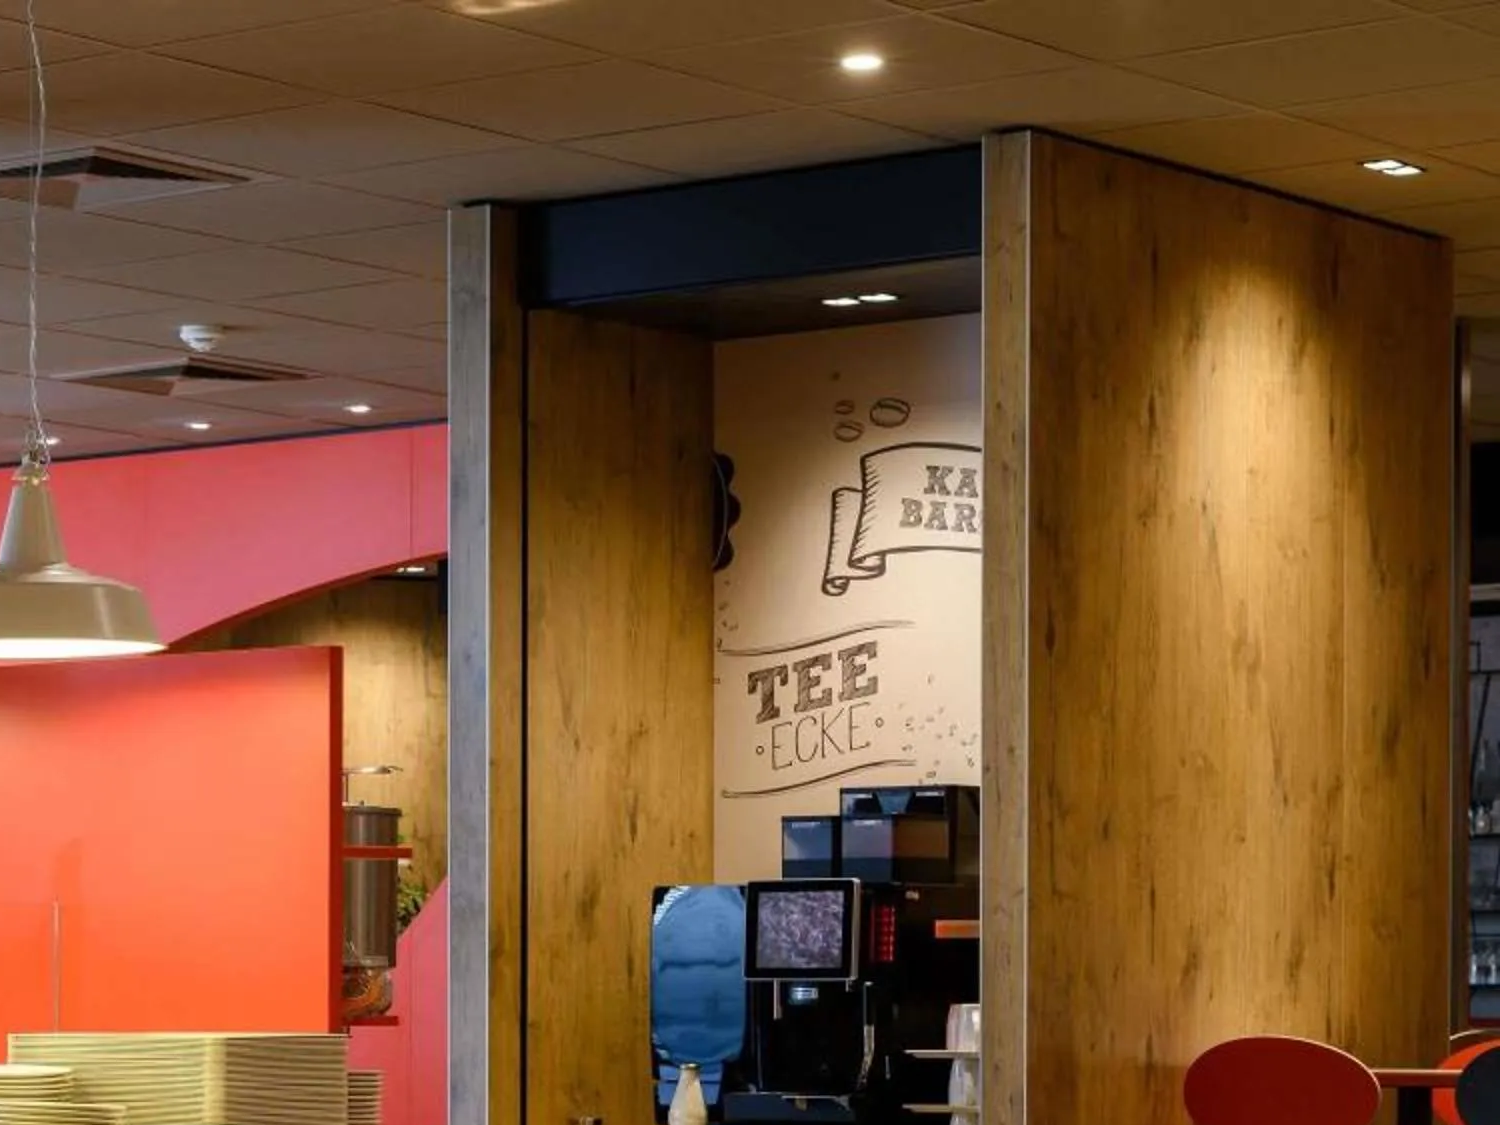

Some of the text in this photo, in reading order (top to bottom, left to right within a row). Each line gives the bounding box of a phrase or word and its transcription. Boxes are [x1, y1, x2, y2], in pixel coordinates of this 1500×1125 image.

[899, 498, 982, 533] BAR
[747, 640, 879, 725] TEE
[771, 701, 871, 771] ECKE
